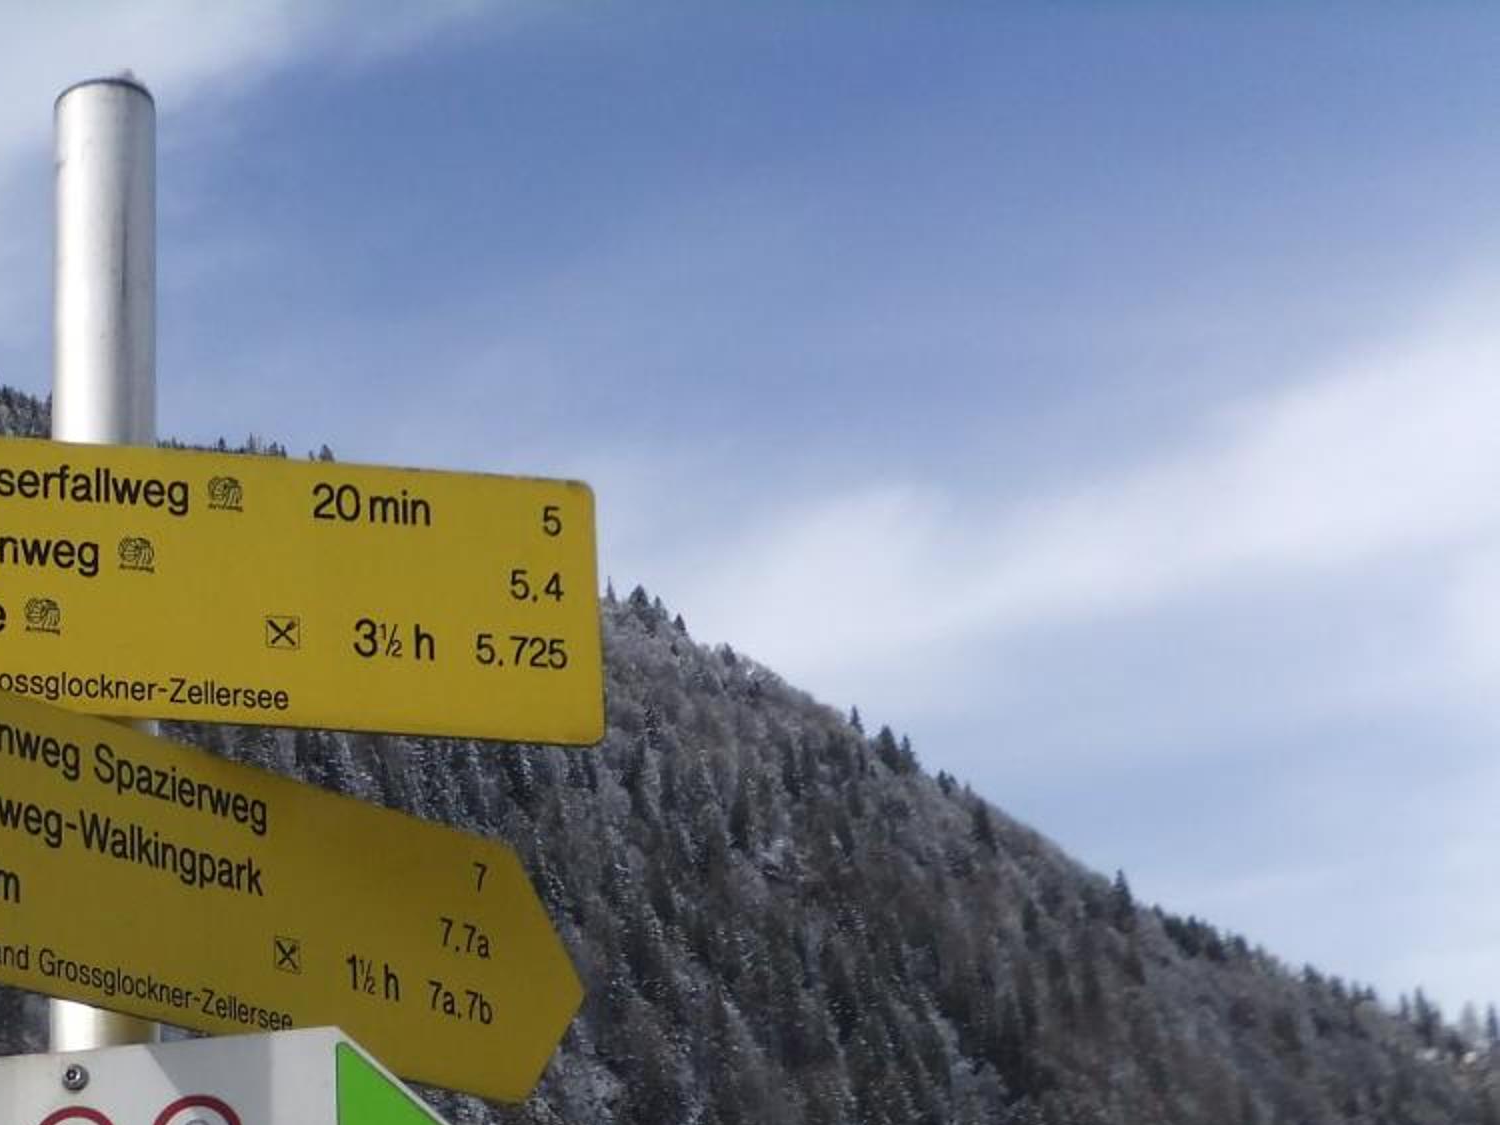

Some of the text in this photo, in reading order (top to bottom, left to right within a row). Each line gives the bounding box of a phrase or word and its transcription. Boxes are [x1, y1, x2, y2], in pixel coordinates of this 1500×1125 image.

[312, 484, 361, 523] 20
[369, 490, 431, 526] min
[542, 505, 561, 537] 5
[510, 570, 564, 603] 5.4
[414, 624, 435, 660] h
[475, 634, 568, 670] 5.725
[93, 743, 268, 836] Spazierweg
[473, 862, 487, 892] 7
[439, 917, 491, 960] 7.7a
[38, 950, 293, 1032] Grossglockner-Zellersee
[384, 963, 400, 1002] h
[428, 980, 493, 1025] 7a.7b
